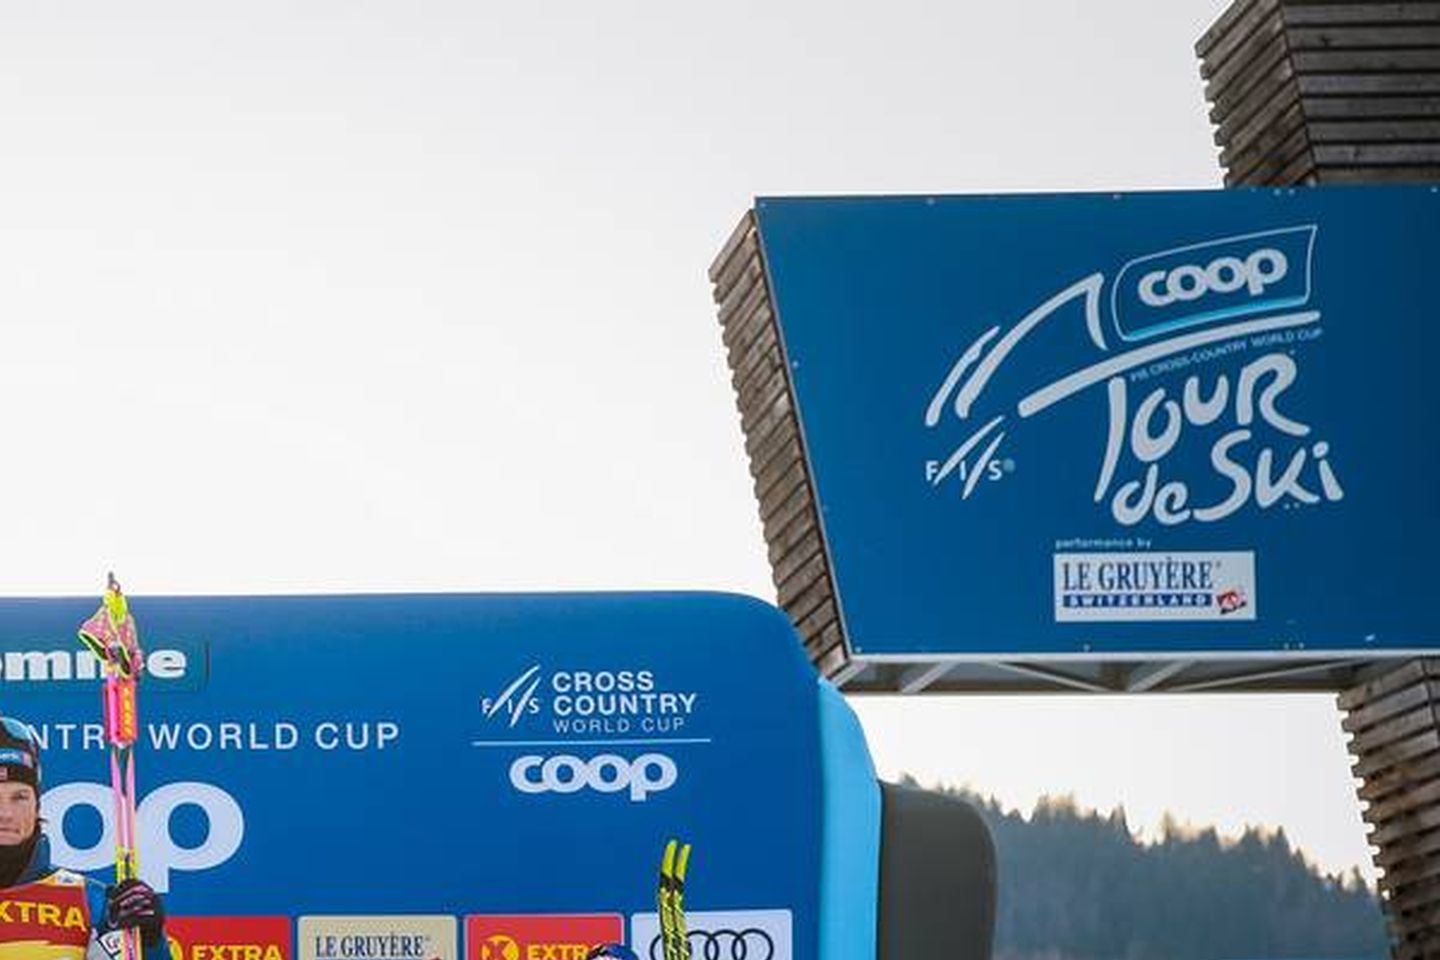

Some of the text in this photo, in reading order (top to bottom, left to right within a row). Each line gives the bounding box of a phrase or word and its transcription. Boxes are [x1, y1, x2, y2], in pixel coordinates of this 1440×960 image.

[1138, 248, 1288, 306] coop
[1110, 429, 1344, 526] de Ski
[1063, 557, 1213, 590] LE GRUYÈRE
[553, 673, 655, 693] CROSS
[553, 693, 697, 717] COUNTRY
[148, 723, 299, 750] WORLD
[315, 722, 400, 750] CUP
[553, 717, 685, 734] WORLD CUP
[509, 752, 678, 803] coop
[316, 931, 425, 957] LE GRUYÈRE
